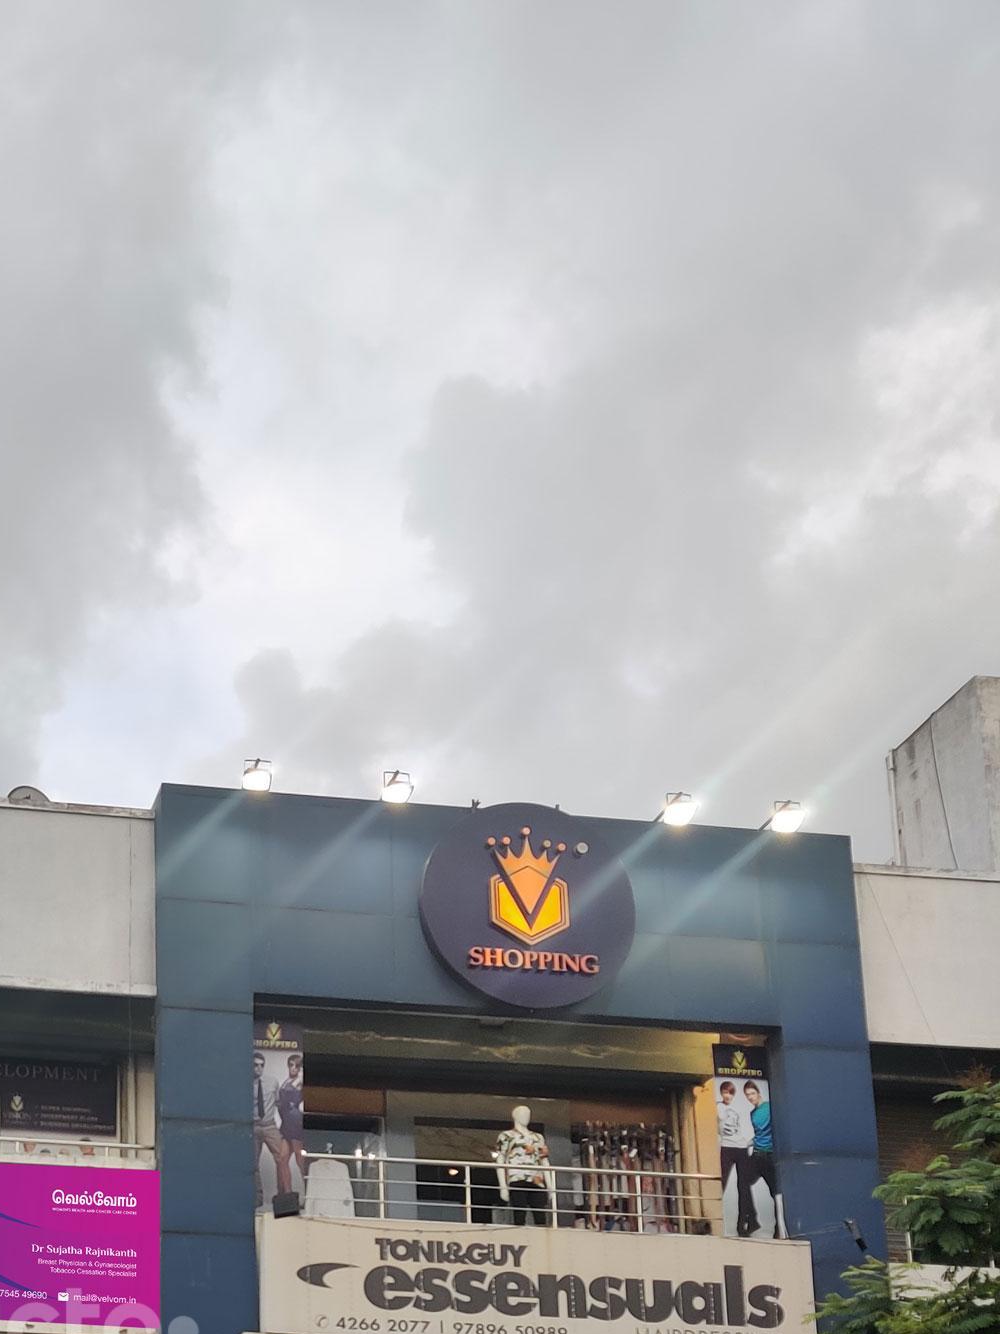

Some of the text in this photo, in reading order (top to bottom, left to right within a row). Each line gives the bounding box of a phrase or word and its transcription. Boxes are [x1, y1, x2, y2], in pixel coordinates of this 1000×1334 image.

[468, 946, 600, 975] SHOPPING
[718, 1067, 762, 1077] SHOPPING
[52, 1189, 137, 1208] வெல்வோம்
[31, 1244, 137, 1258] Dr Sujatha Rajnikanth
[374, 1237, 528, 1268] TONI&GUY
[58, 1259, 87, 1267] Physician
[50, 1266, 137, 1277] Tobacco Cessation Specialist
[21, 1290, 47, 1299] 49690
[73, 1293, 137, 1304] mail@velvom.in
[363, 1264, 785, 1329] essensuals
[336, 1317, 380, 1332] 4266
[387, 1319, 431, 1333] 2077
